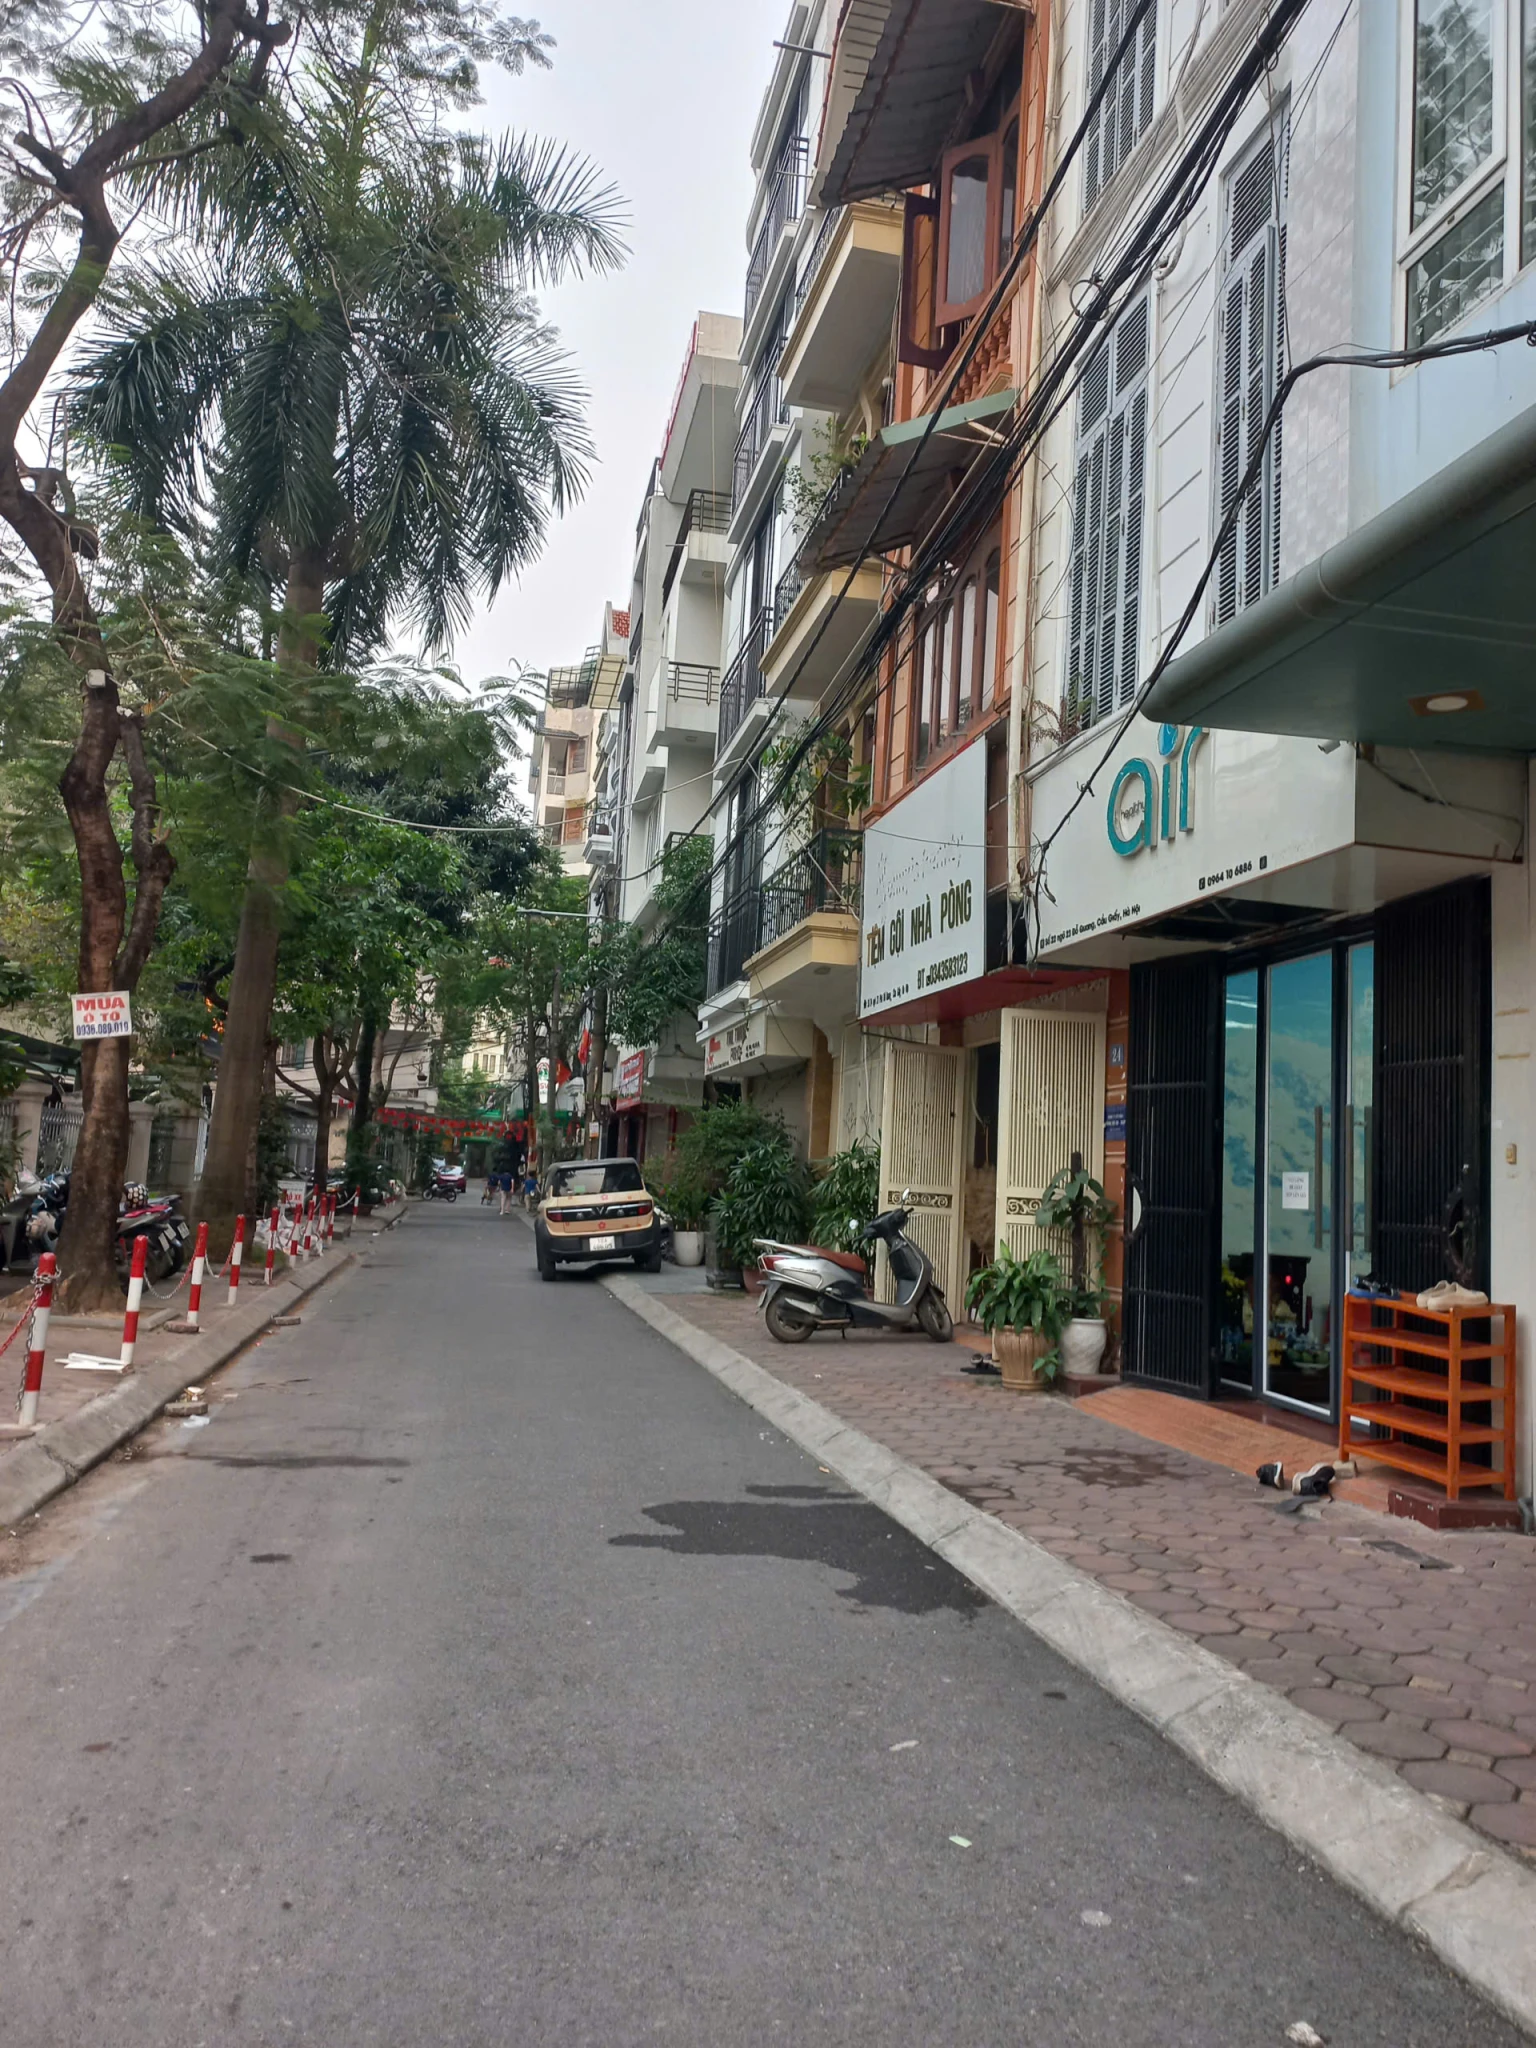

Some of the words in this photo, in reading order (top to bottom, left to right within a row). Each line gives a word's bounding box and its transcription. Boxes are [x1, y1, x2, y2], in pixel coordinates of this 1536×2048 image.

[1107, 724, 1206, 856] air
[1207, 871, 1224, 887] 0964
[1226, 868, 1233, 880] 10
[1234, 860, 1253, 877] 6886
[889, 908, 905, 958] GỘI
[911, 893, 933, 948] NHÀ
[941, 879, 972, 934] PÒNG
[1123, 906, 1131, 917] Hà
[917, 968, 926, 990] ĐT
[76, 997, 124, 1011] MUA
[83, 1012, 95, 1024] Ô
[101, 1010, 120, 1022] TÔ
[1112, 1047, 1121, 1062] 24
